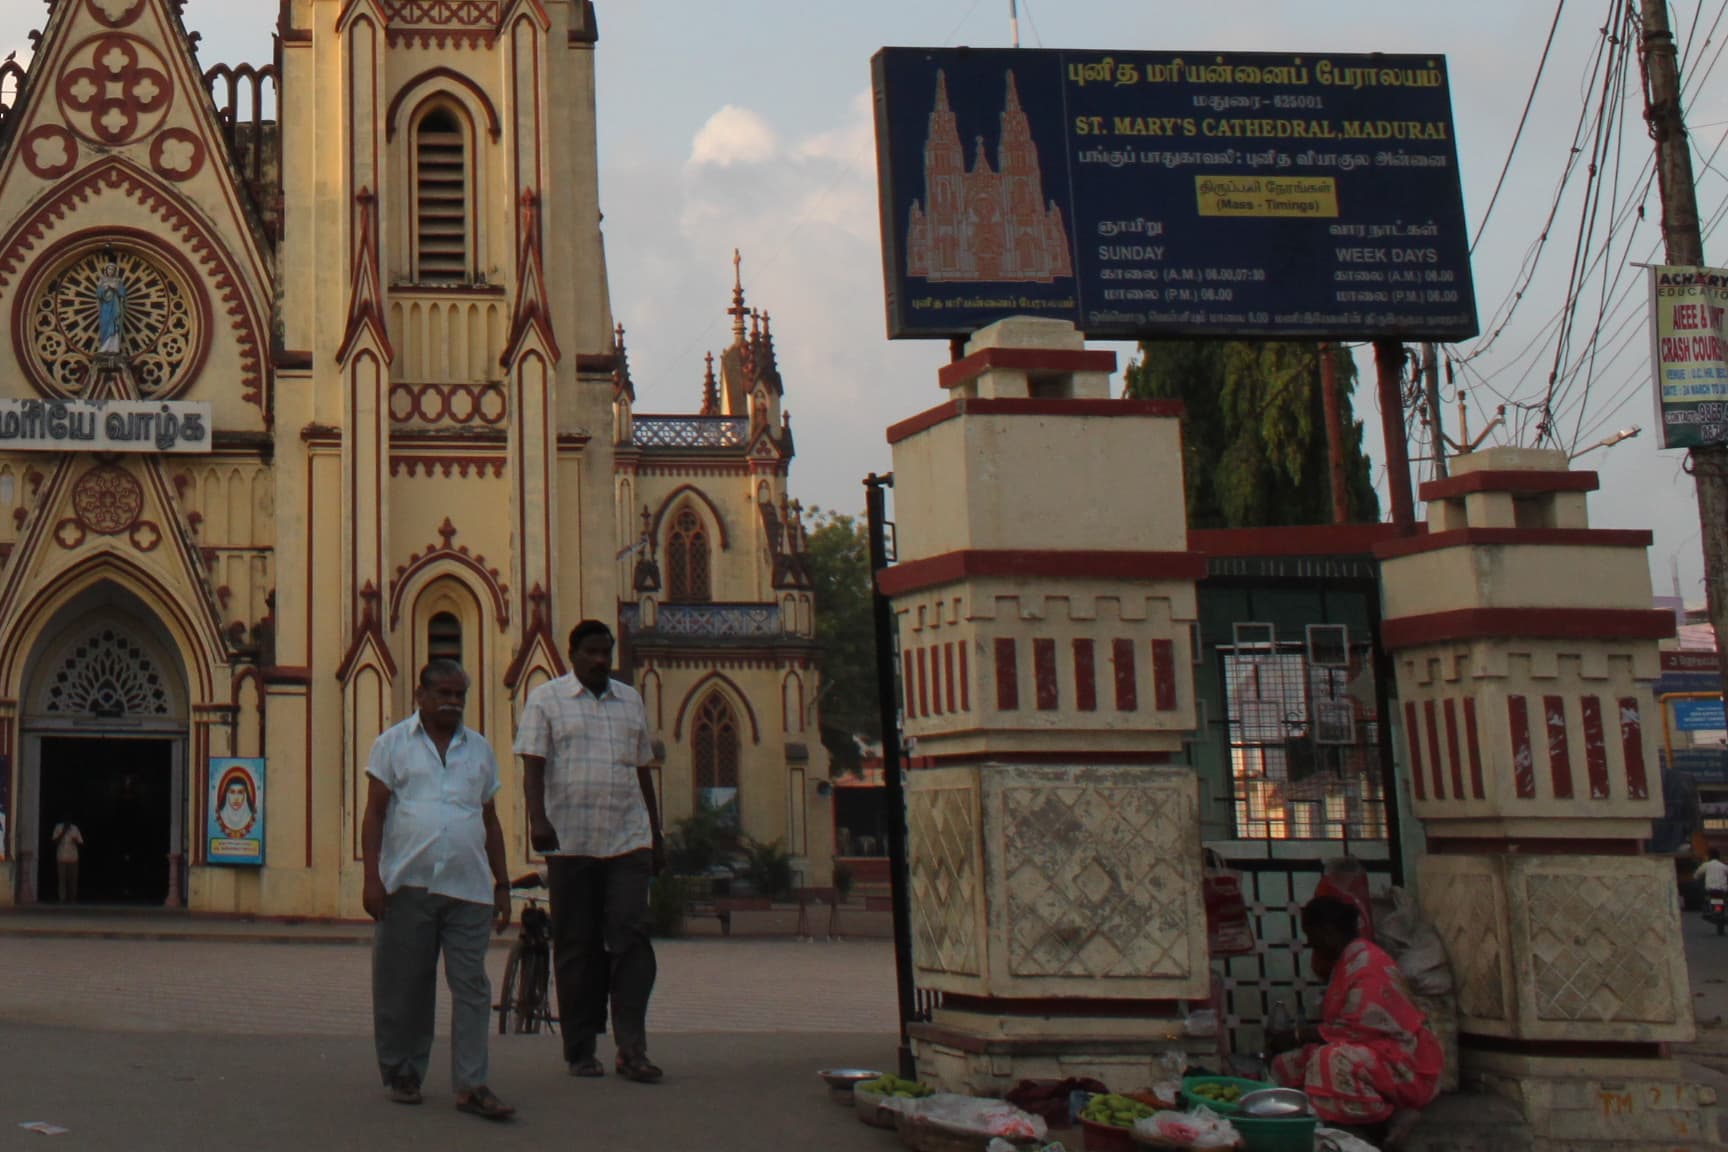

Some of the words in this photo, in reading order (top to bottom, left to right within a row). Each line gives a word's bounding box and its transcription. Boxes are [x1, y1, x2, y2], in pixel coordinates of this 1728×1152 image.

[1068, 57, 1138, 87] புனித
[1147, 56, 1308, 85] மரியன்னைப்
[1316, 60, 1442, 89] பேராலயம்
[1075, 116, 1108, 136] ST.
[1114, 117, 1197, 137] MARY'S
[1246, 150, 1292, 169] புனித
[1098, 245, 1166, 261] SUNDAY
[1336, 248, 1387, 263] WEEK
[1391, 248, 1438, 263] DAYS
[1662, 337, 1691, 362] CRASH
[105, 404, 206, 450] வாழ்க
